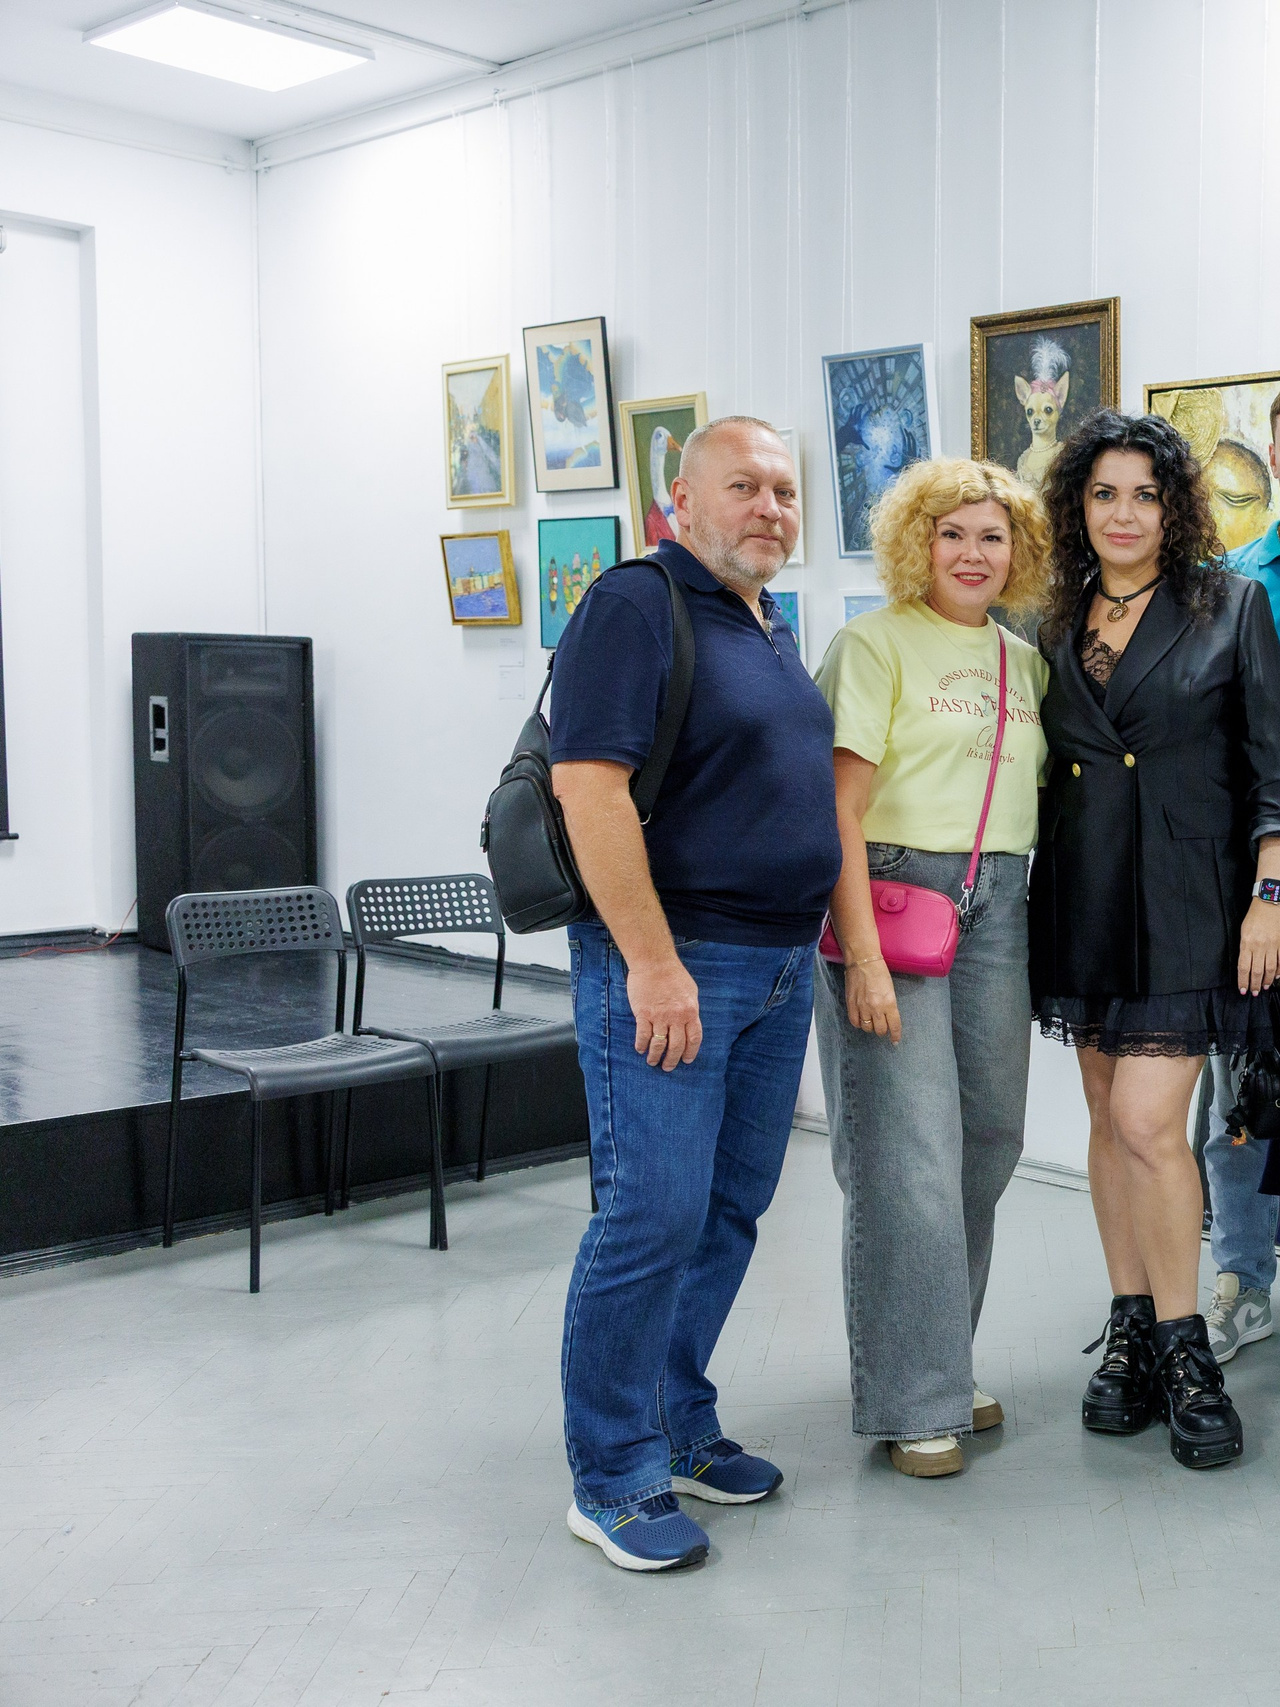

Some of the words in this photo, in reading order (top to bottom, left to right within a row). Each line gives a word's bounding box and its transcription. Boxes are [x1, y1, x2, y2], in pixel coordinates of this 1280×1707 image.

[938, 668, 993, 691] CONSUMED
[994, 678, 1026, 704] DILY
[929, 696, 984, 718] PASTA
[976, 725, 995, 748] Clu
[966, 747, 978, 759] It's
[985, 750, 1015, 766] liftyle
